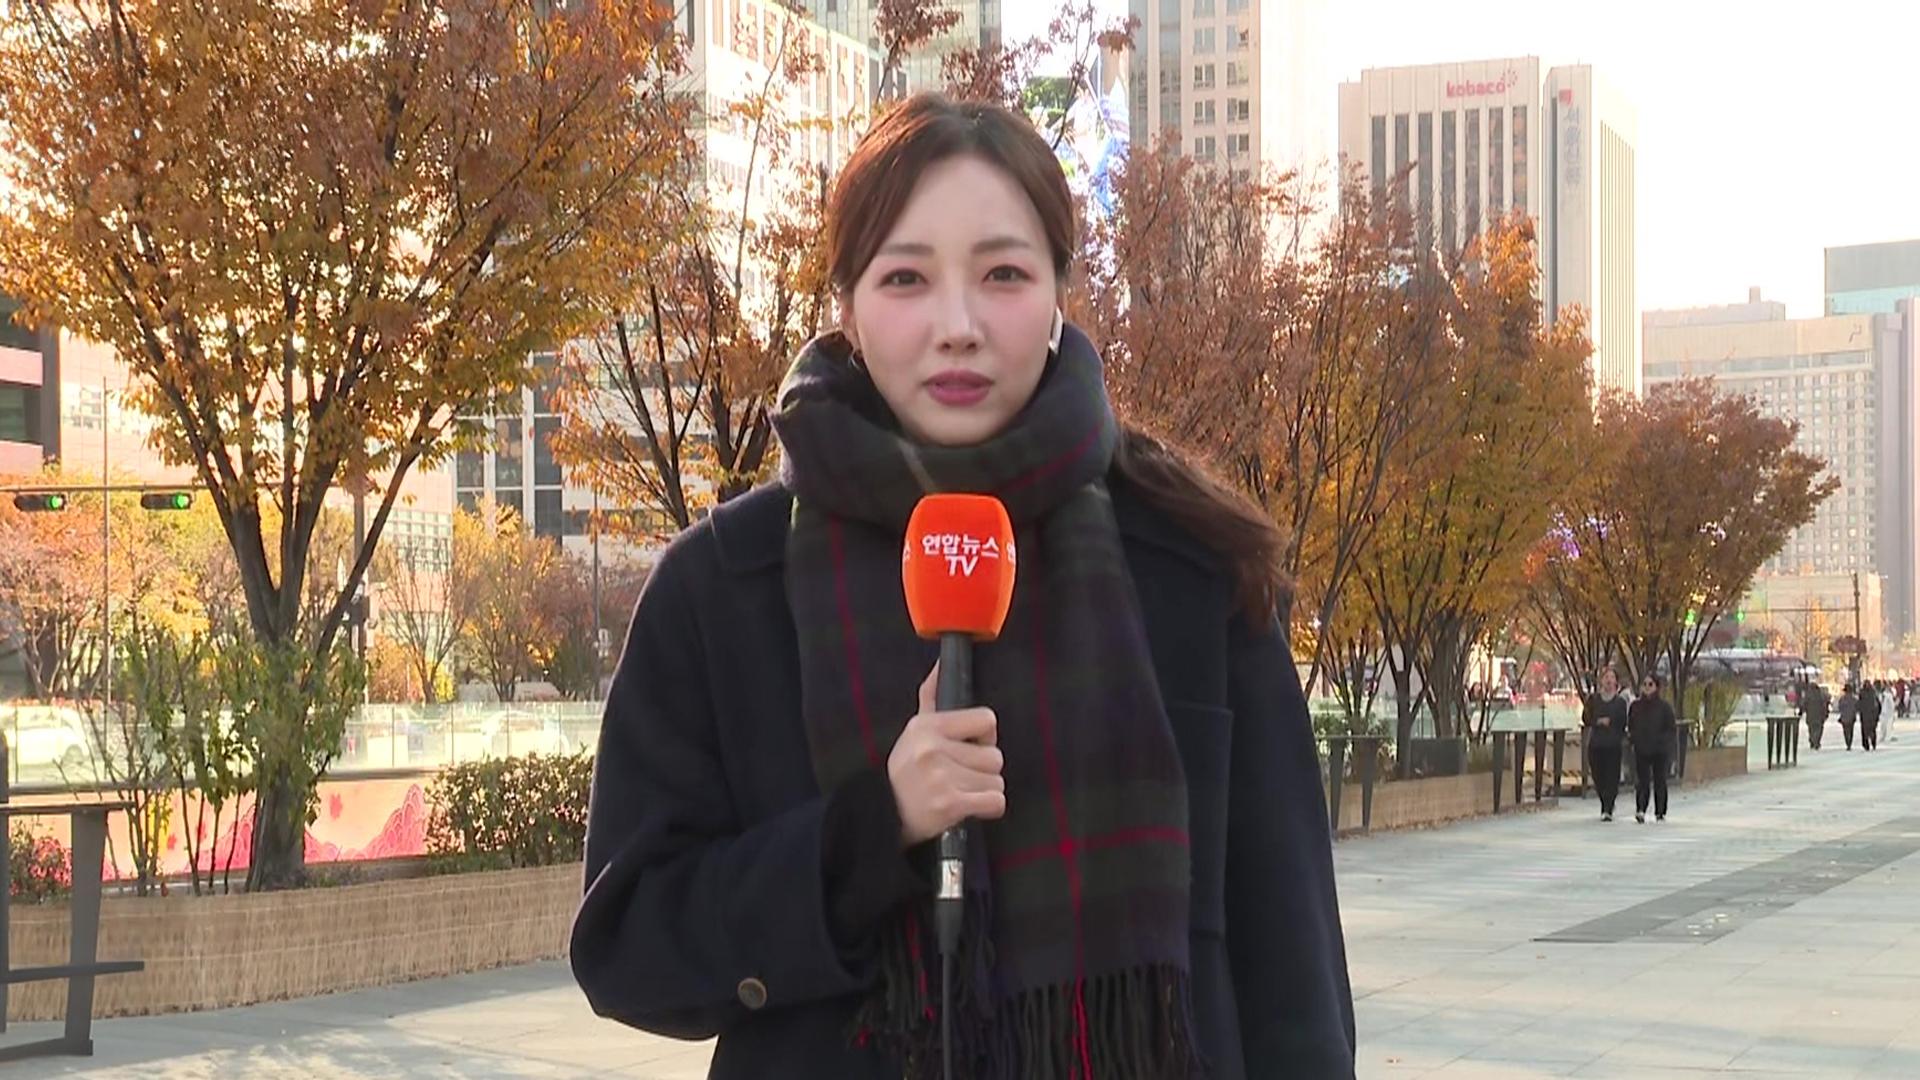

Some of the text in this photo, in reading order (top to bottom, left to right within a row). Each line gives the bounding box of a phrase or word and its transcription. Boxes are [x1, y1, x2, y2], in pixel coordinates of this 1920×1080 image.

[1446, 80, 1506, 98] kobaco
[921, 534, 999, 559] 연합뉴스
[945, 555, 979, 577] TV
